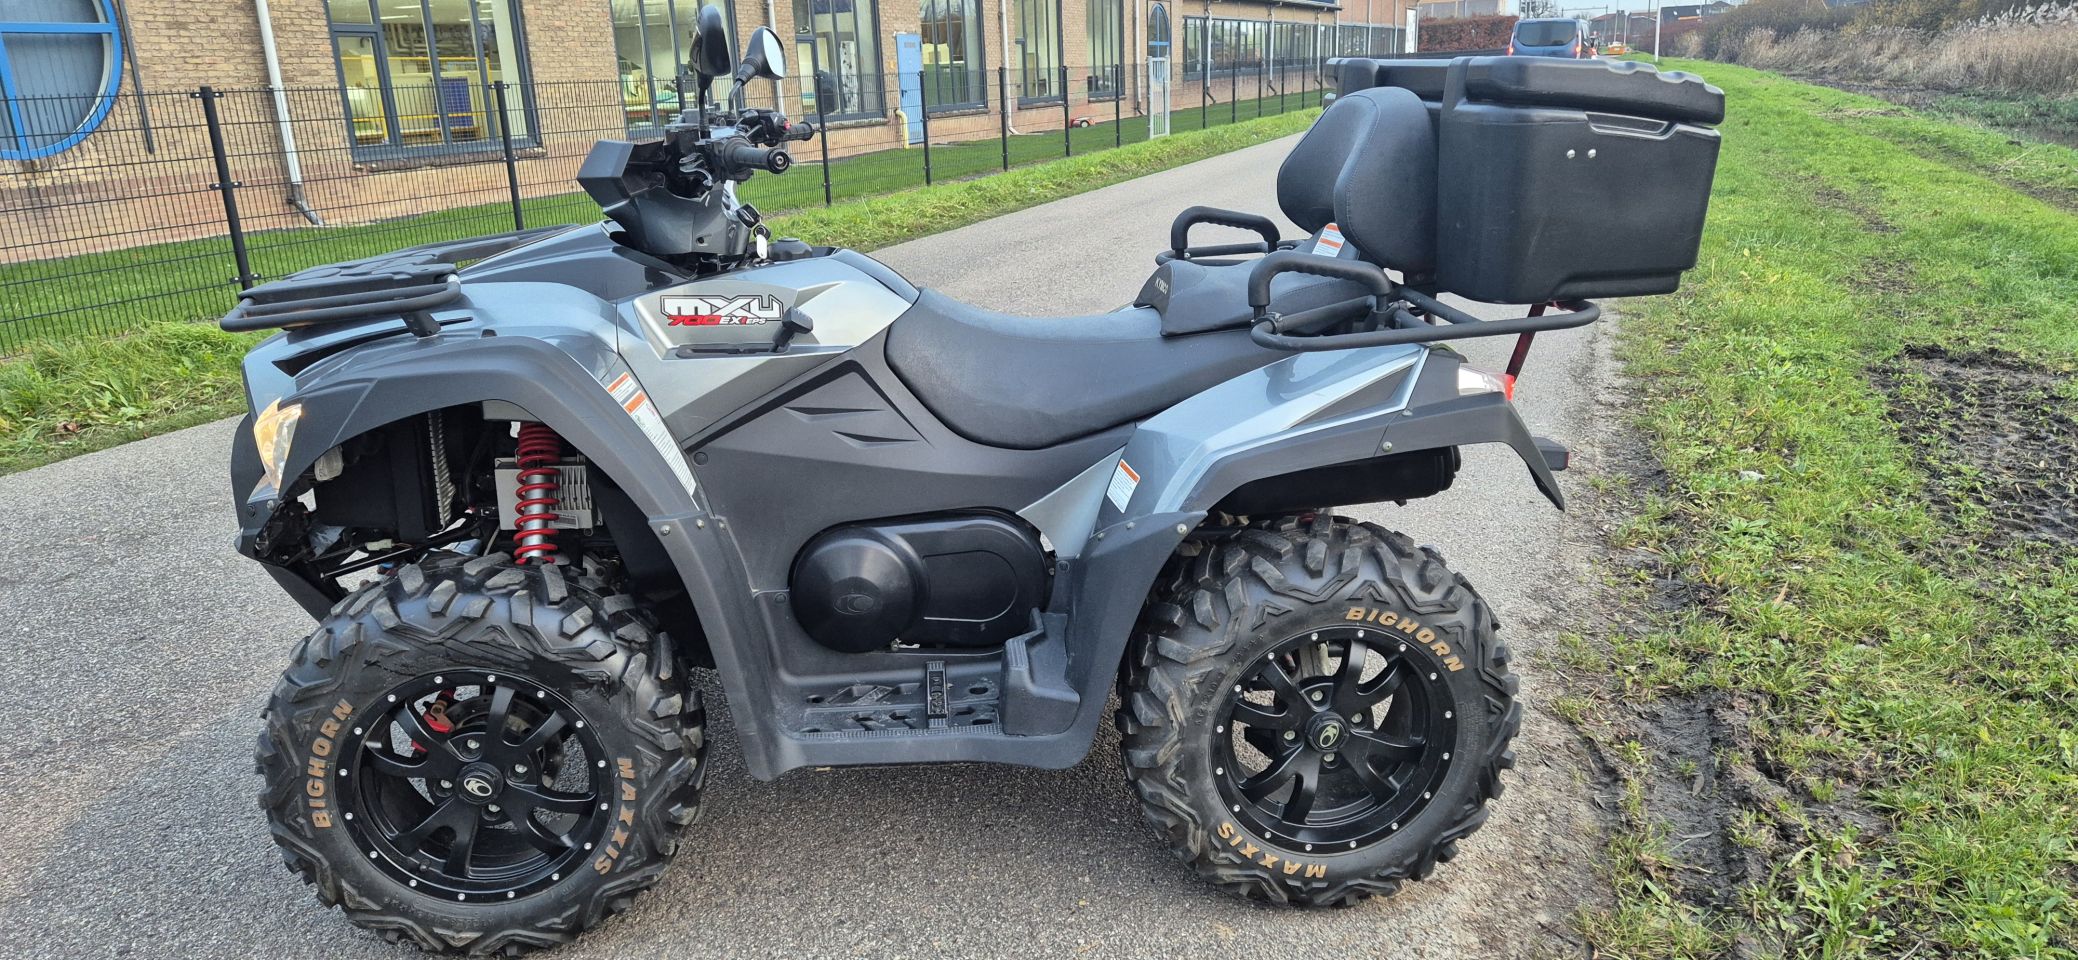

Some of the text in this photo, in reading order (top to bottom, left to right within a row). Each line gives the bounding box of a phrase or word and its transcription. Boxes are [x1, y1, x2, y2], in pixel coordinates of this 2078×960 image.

[667, 314, 721, 326] 700
[1345, 607, 1465, 672] BIGHORN
[306, 698, 353, 828] BIGHORN
[594, 757, 637, 876] MAXXIS
[1217, 822, 1328, 878] MAXXIS
